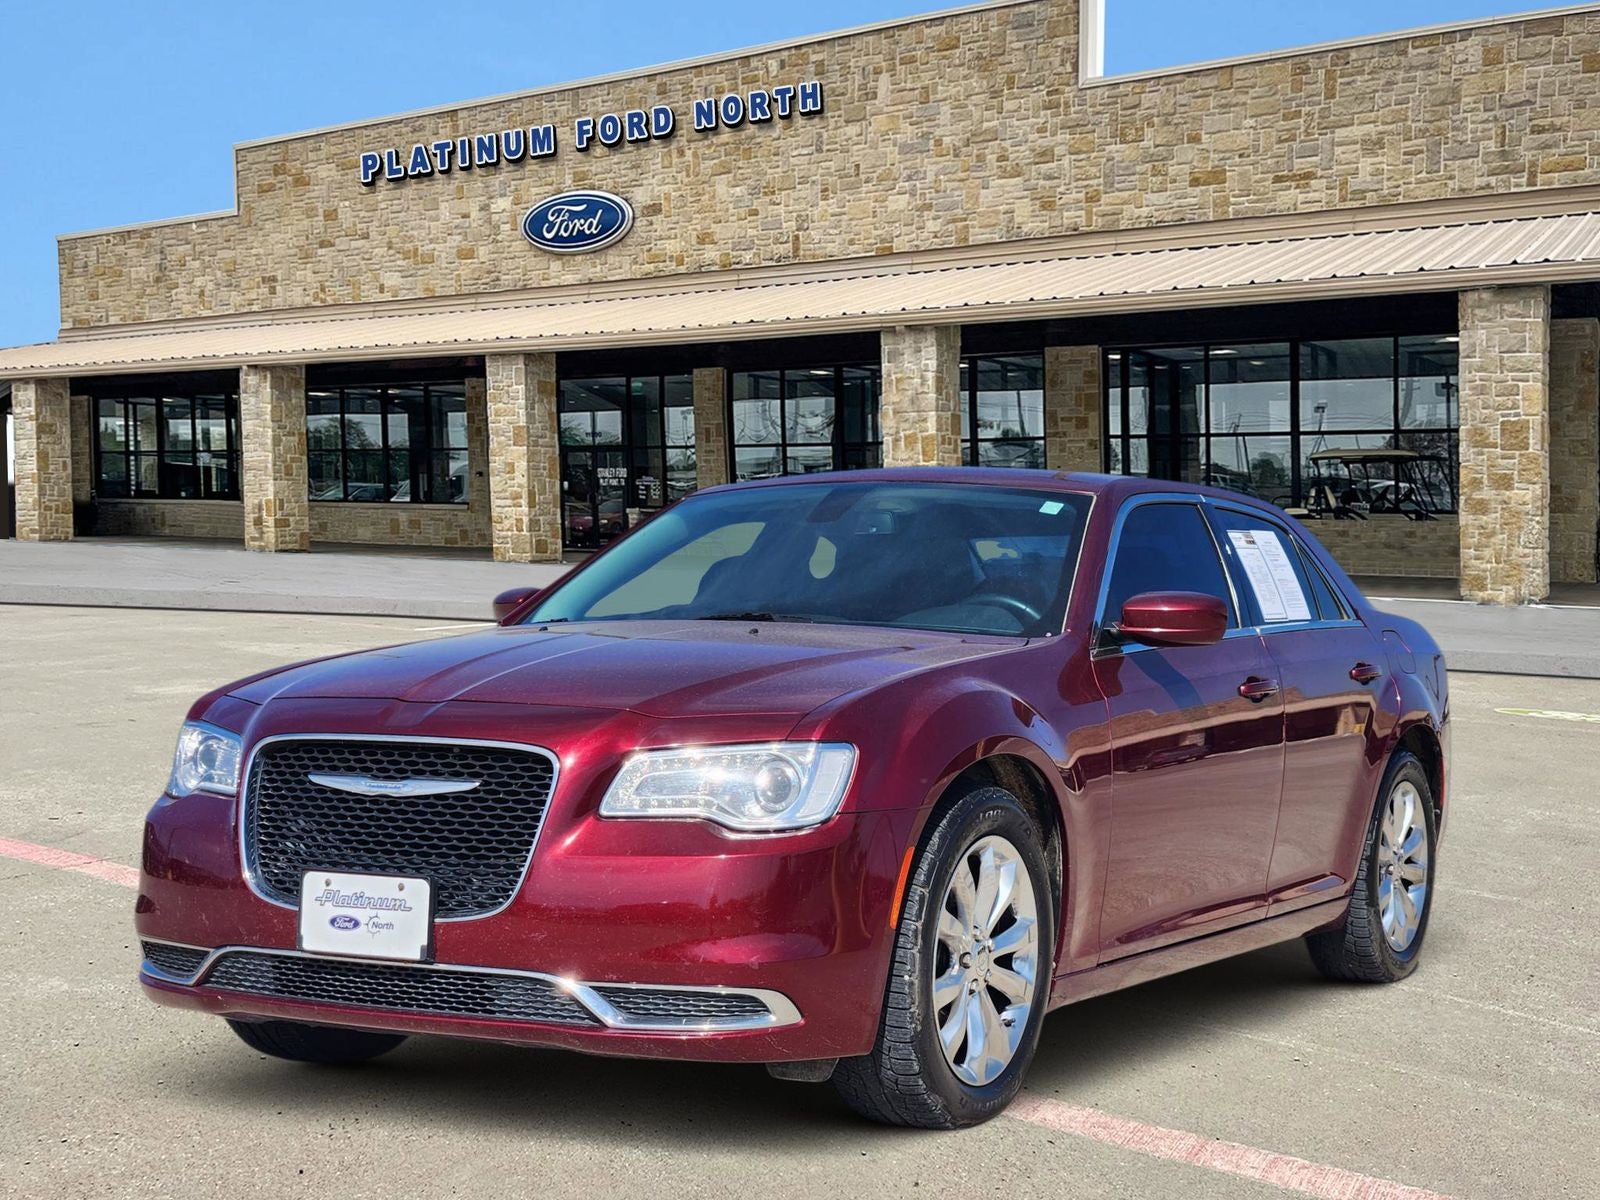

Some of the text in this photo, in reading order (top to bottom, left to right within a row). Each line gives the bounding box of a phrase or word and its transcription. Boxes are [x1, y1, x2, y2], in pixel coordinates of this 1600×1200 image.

[360, 80, 824, 186] PLATINUM FORD NORTH
[542, 203, 603, 240] Ford
[315, 889, 412, 911] Platinum
[334, 917, 394, 931] Ford North
